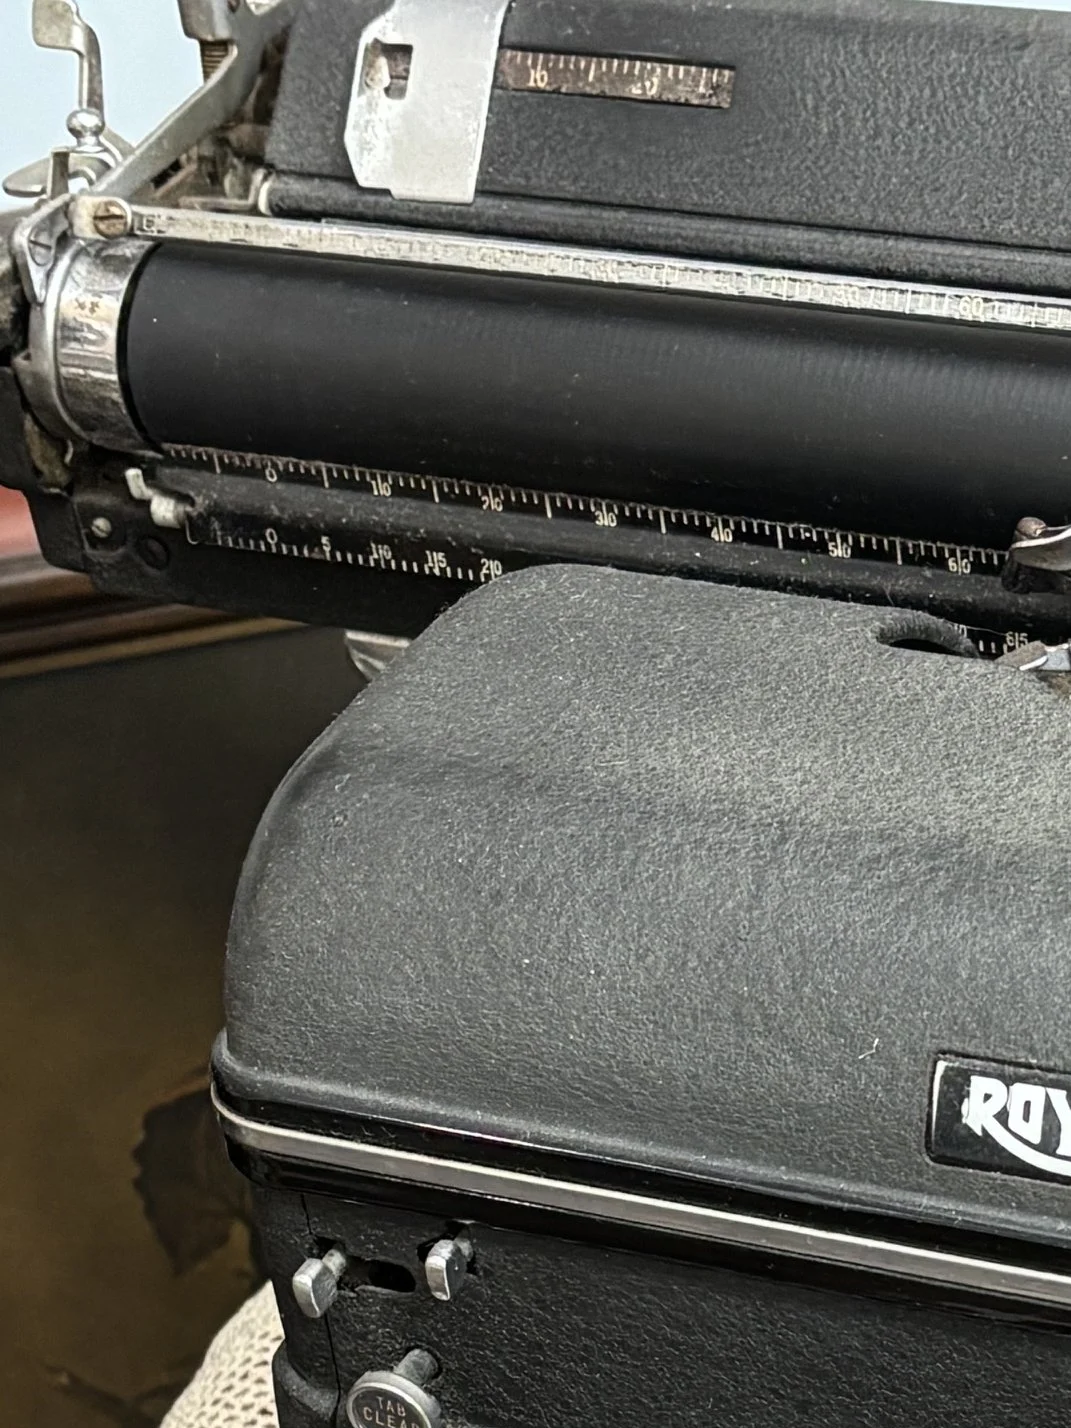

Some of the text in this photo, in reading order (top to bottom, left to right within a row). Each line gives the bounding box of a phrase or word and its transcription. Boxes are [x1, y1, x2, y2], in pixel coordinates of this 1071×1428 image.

[265, 528, 278, 544] 0
[321, 536, 331, 551] 5
[370, 543, 391, 560] 10
[425, 551, 446, 568] 15
[480, 557, 502, 575] 20
[595, 511, 617, 527] 30
[710, 527, 733, 543] 40
[828, 541, 851, 558] 50
[948, 557, 971, 574] 60
[376, 1396, 407, 1417] TAB
